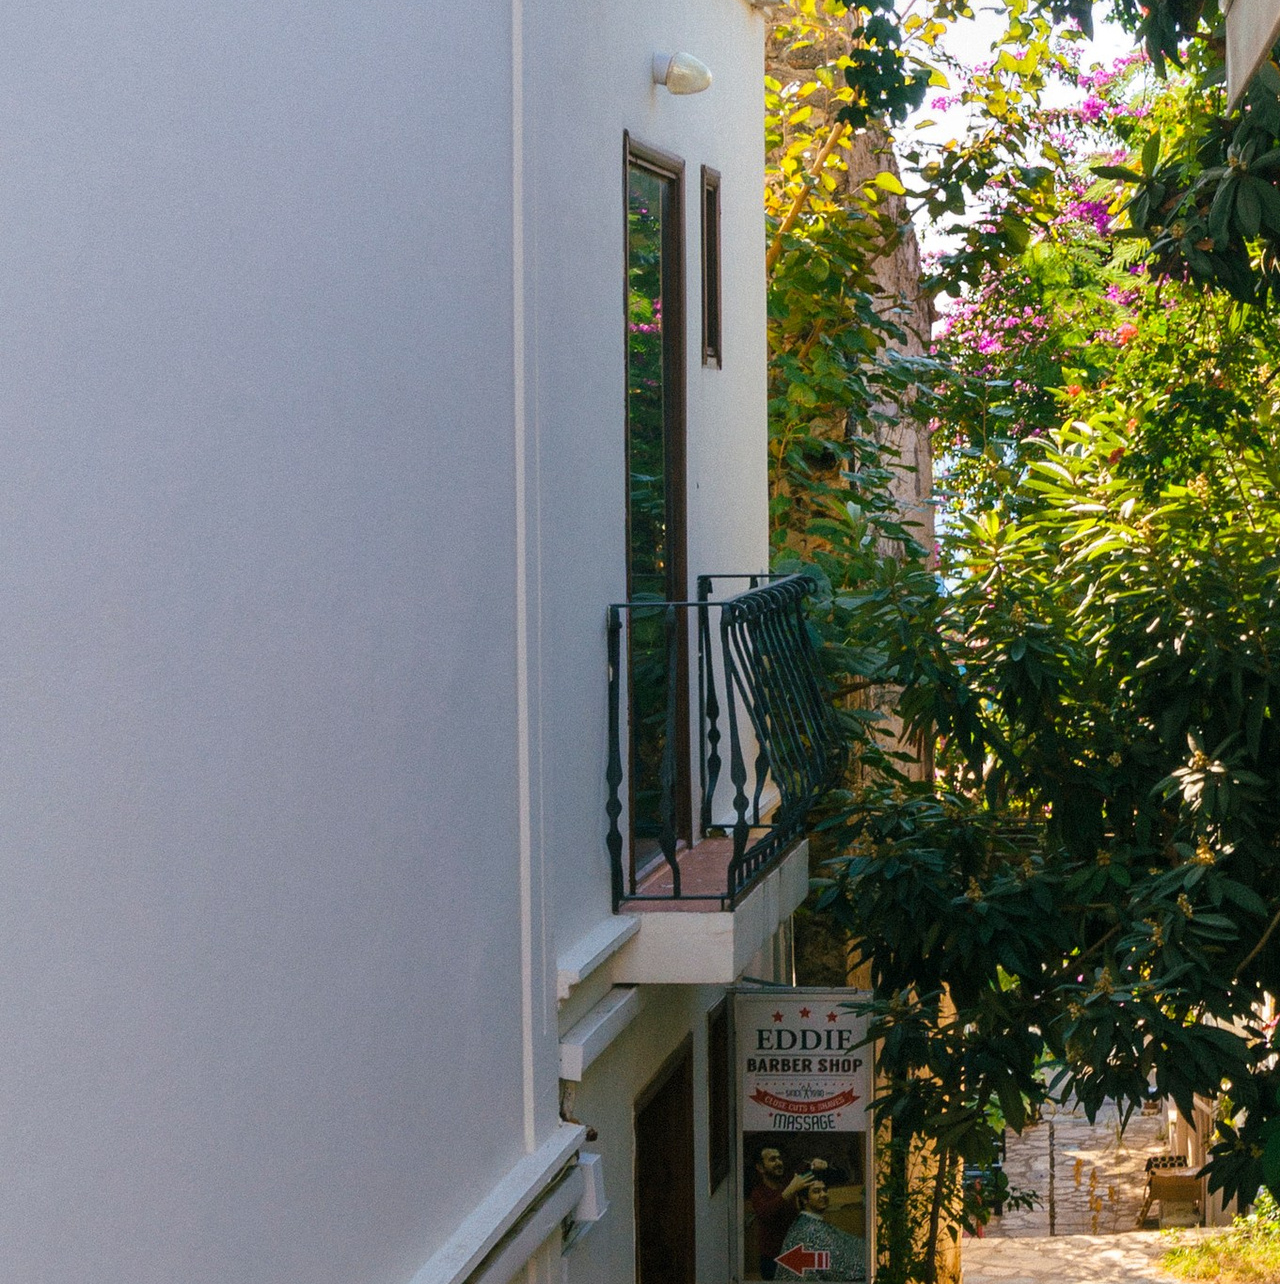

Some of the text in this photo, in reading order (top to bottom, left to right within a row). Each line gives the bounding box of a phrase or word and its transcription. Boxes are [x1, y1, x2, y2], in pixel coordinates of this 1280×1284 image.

[756, 1028, 852, 1051] EDDIE
[747, 1057, 863, 1073] BARBER SHOP
[788, 1103, 808, 1112] CUTS
[773, 1113, 836, 1131] MASSAGE
